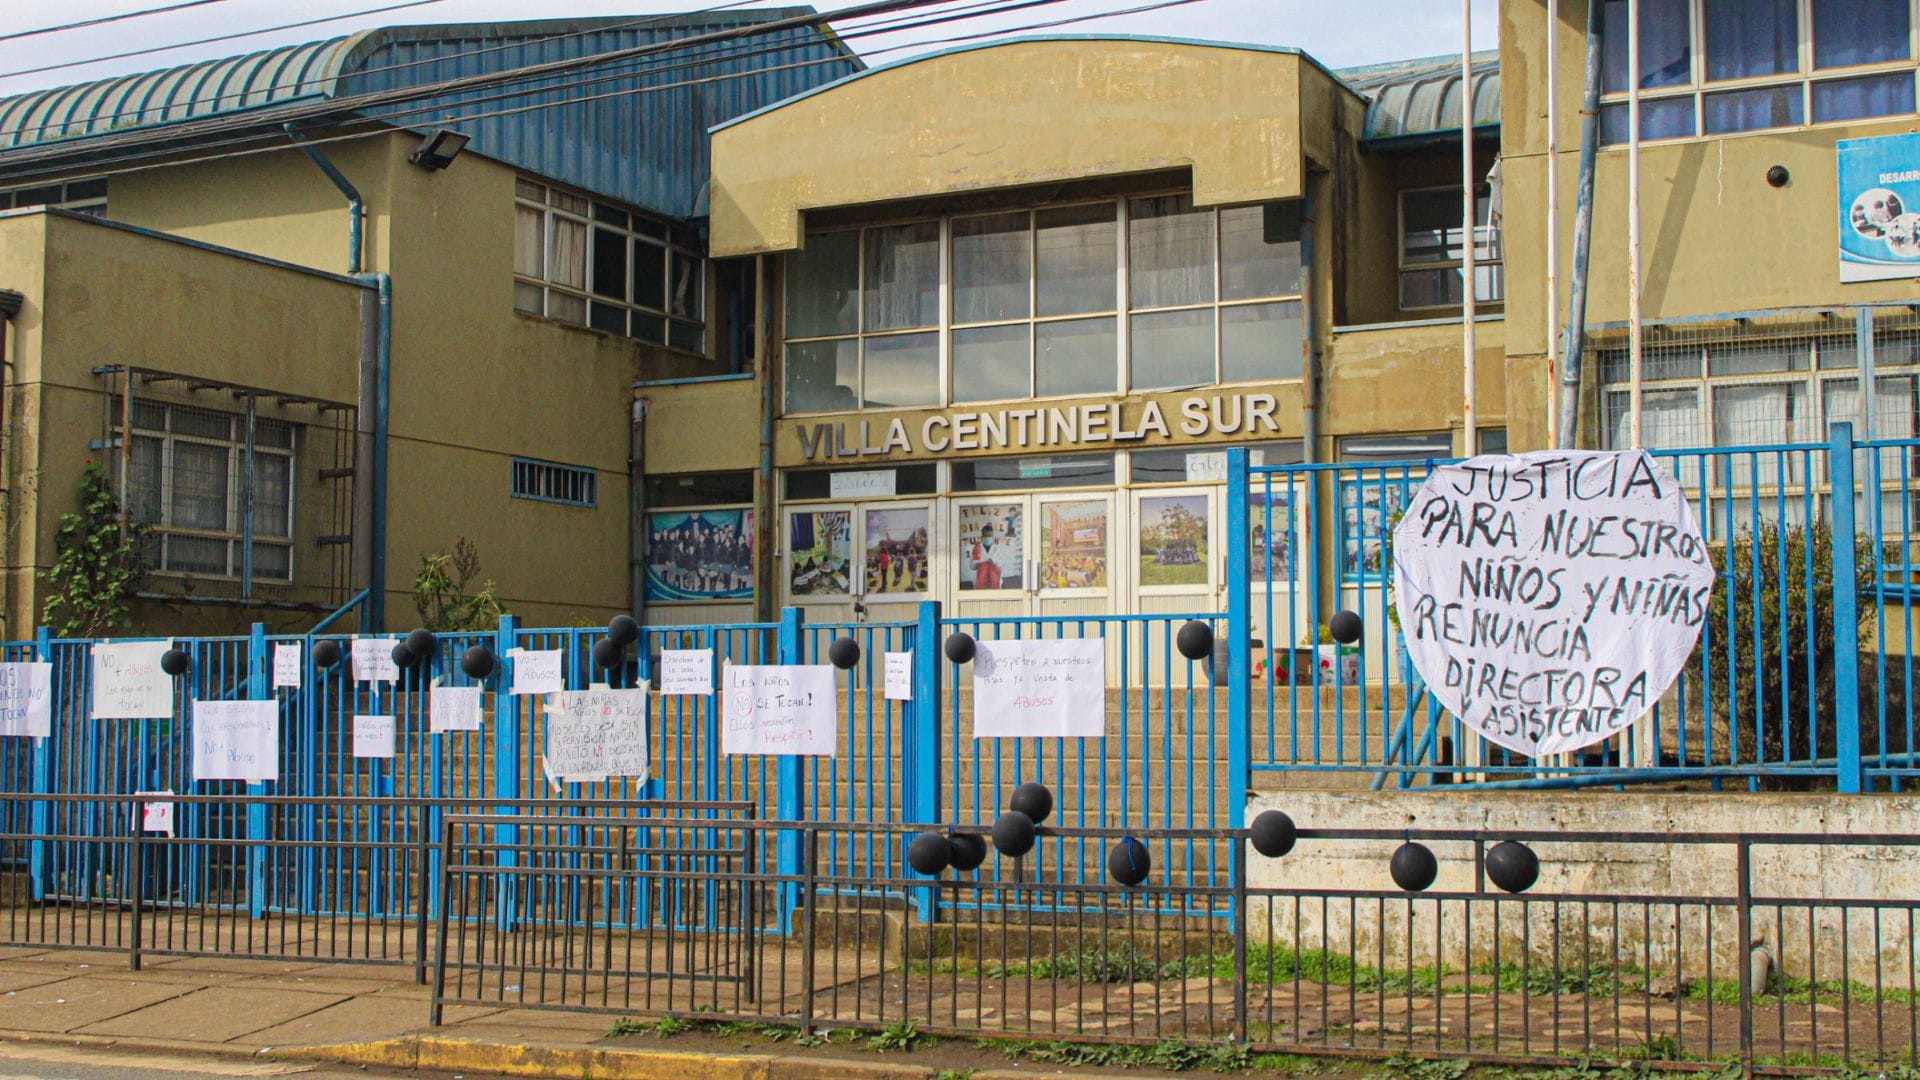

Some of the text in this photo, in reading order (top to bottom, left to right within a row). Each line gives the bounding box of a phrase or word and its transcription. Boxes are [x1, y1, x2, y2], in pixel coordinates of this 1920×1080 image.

[1879, 170, 1920, 185] DESARR
[796, 393, 1280, 459] VILLA CENTINELA SUR
[1451, 453, 1663, 502] JUSTICIA
[1420, 495, 1707, 566] PARA NUESTROS
[1458, 554, 1709, 627] NIÑOS Y NIÑAS
[1413, 593, 1593, 663] RENUNCIA
[101, 653, 116, 669] NO
[1444, 654, 1647, 709] DIRECTORA
[1481, 702, 1625, 744] ASISTENTE
